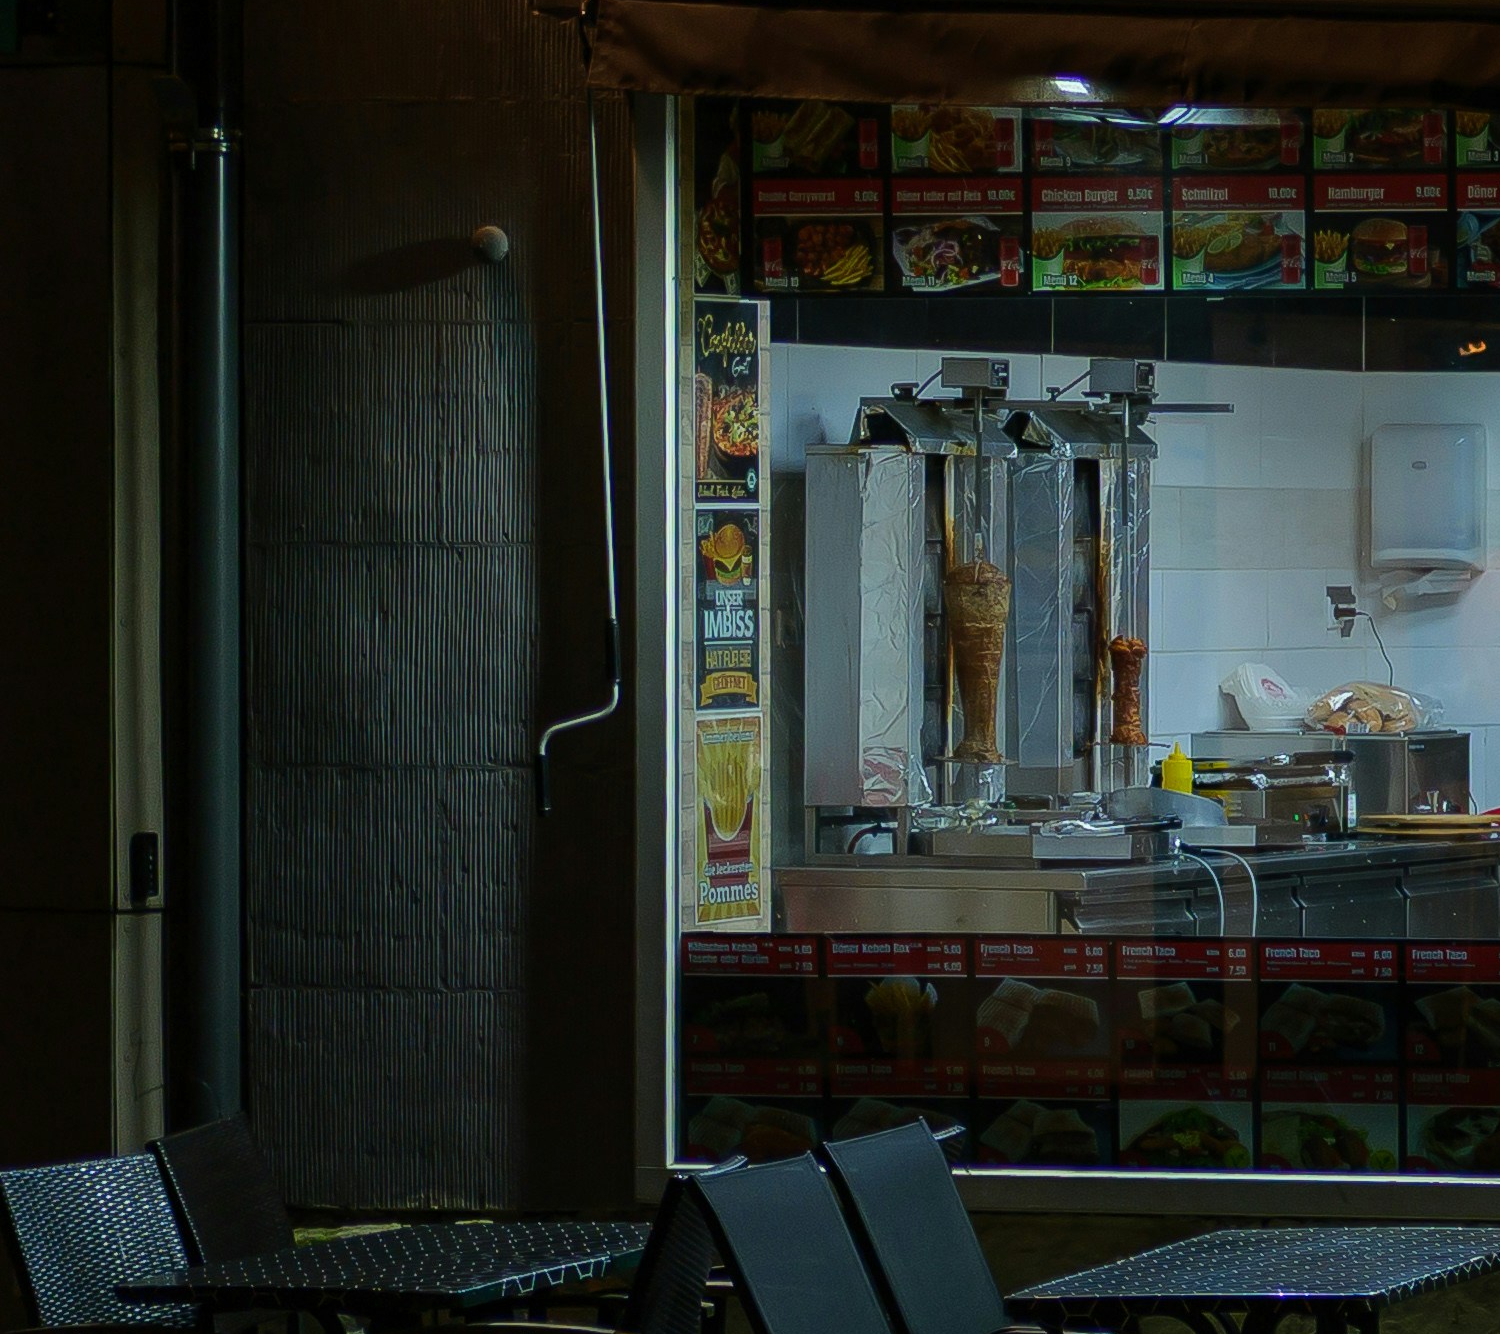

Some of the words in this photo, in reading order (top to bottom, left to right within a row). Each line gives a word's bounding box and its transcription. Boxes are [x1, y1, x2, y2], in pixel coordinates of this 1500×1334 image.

[1348, 153, 1354, 163] 2
[1041, 190, 1082, 202] Chicken
[1085, 190, 1118, 203] Burger
[1182, 188, 1228, 201] Schnitzel
[1328, 187, 1385, 201] Hamburger
[1468, 186, 1498, 198] Döner
[1067, 275, 1078, 285] 12
[1208, 273, 1214, 283] 4
[1351, 272, 1357, 283] 5
[715, 590, 743, 606] UNSER
[704, 609, 755, 639] IMBISS
[699, 881, 759, 905] Pommes
[980, 944, 1010, 955] French
[1013, 944, 1033, 955] Taco
[1122, 945, 1154, 956] French
[1156, 945, 1176, 956] Taco
[1265, 947, 1296, 958] French
[1298, 948, 1320, 959] Taco
[1412, 949, 1444, 960] French
[1445, 950, 1467, 960] Taco
[1268, 1043, 1277, 1052] 11
